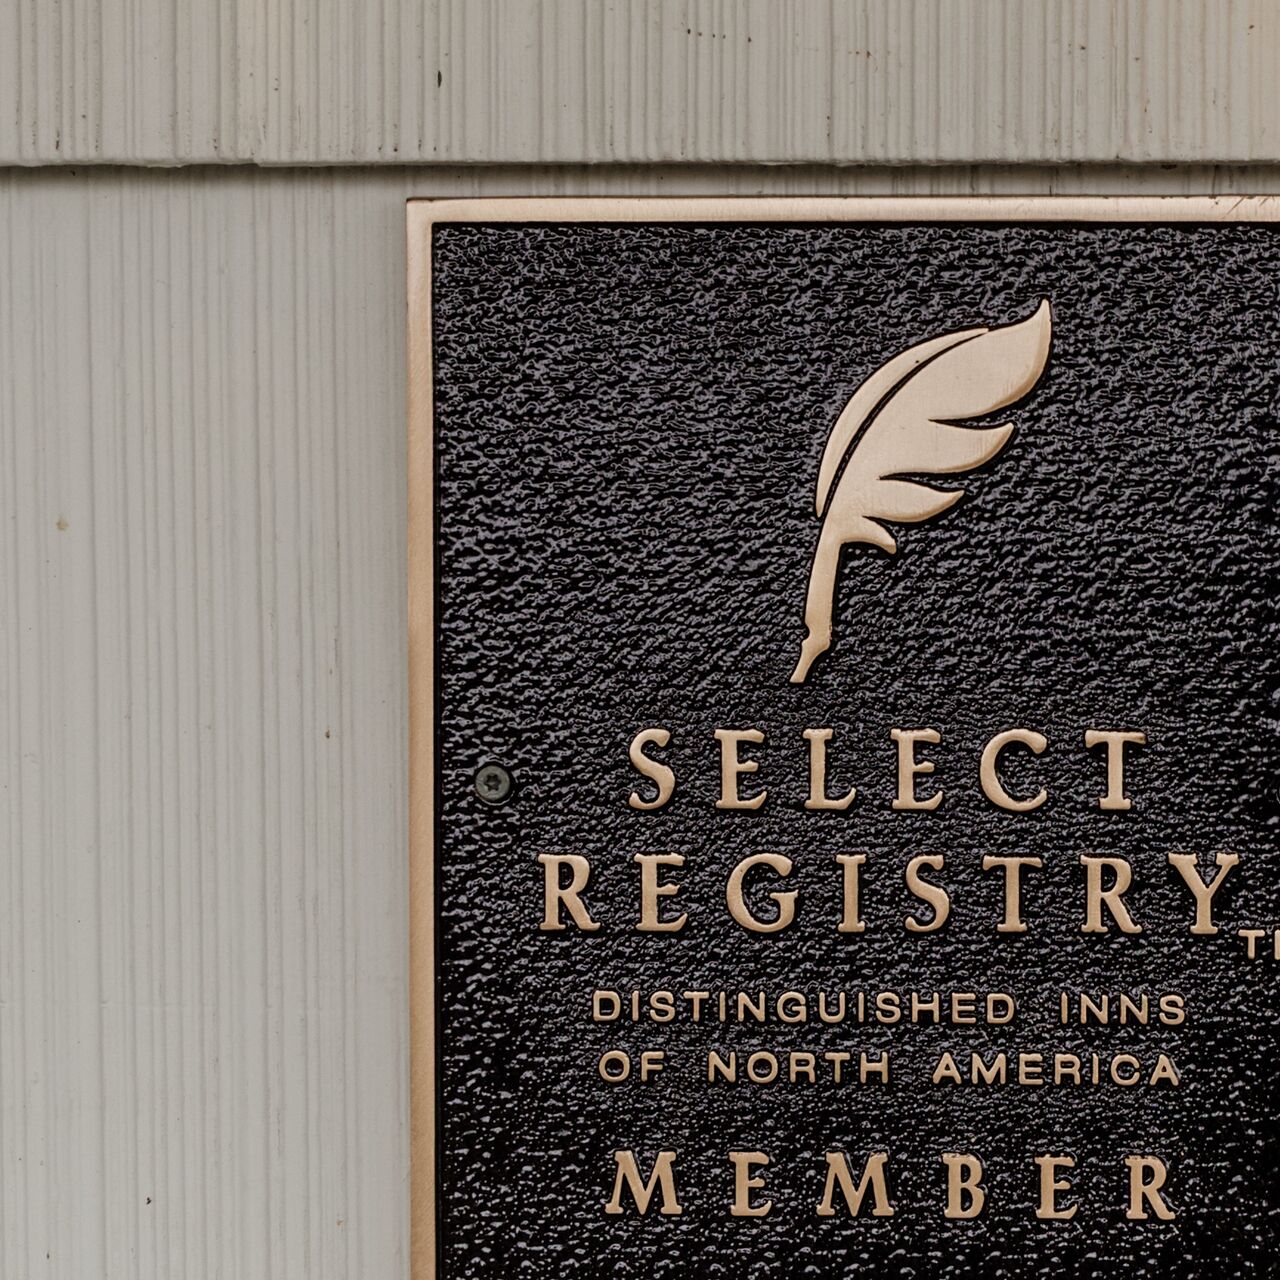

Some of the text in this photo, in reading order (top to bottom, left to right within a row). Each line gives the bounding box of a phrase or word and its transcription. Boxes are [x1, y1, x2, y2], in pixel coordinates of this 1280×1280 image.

[628, 727, 1148, 812] SELECT
[537, 852, 1240, 936] REGISTRY
[592, 990, 1188, 1026] DISTINGUISHED INNS
[598, 1050, 1181, 1087] OF NORTH AMERICA
[605, 1150, 1179, 1222] MEMBER
